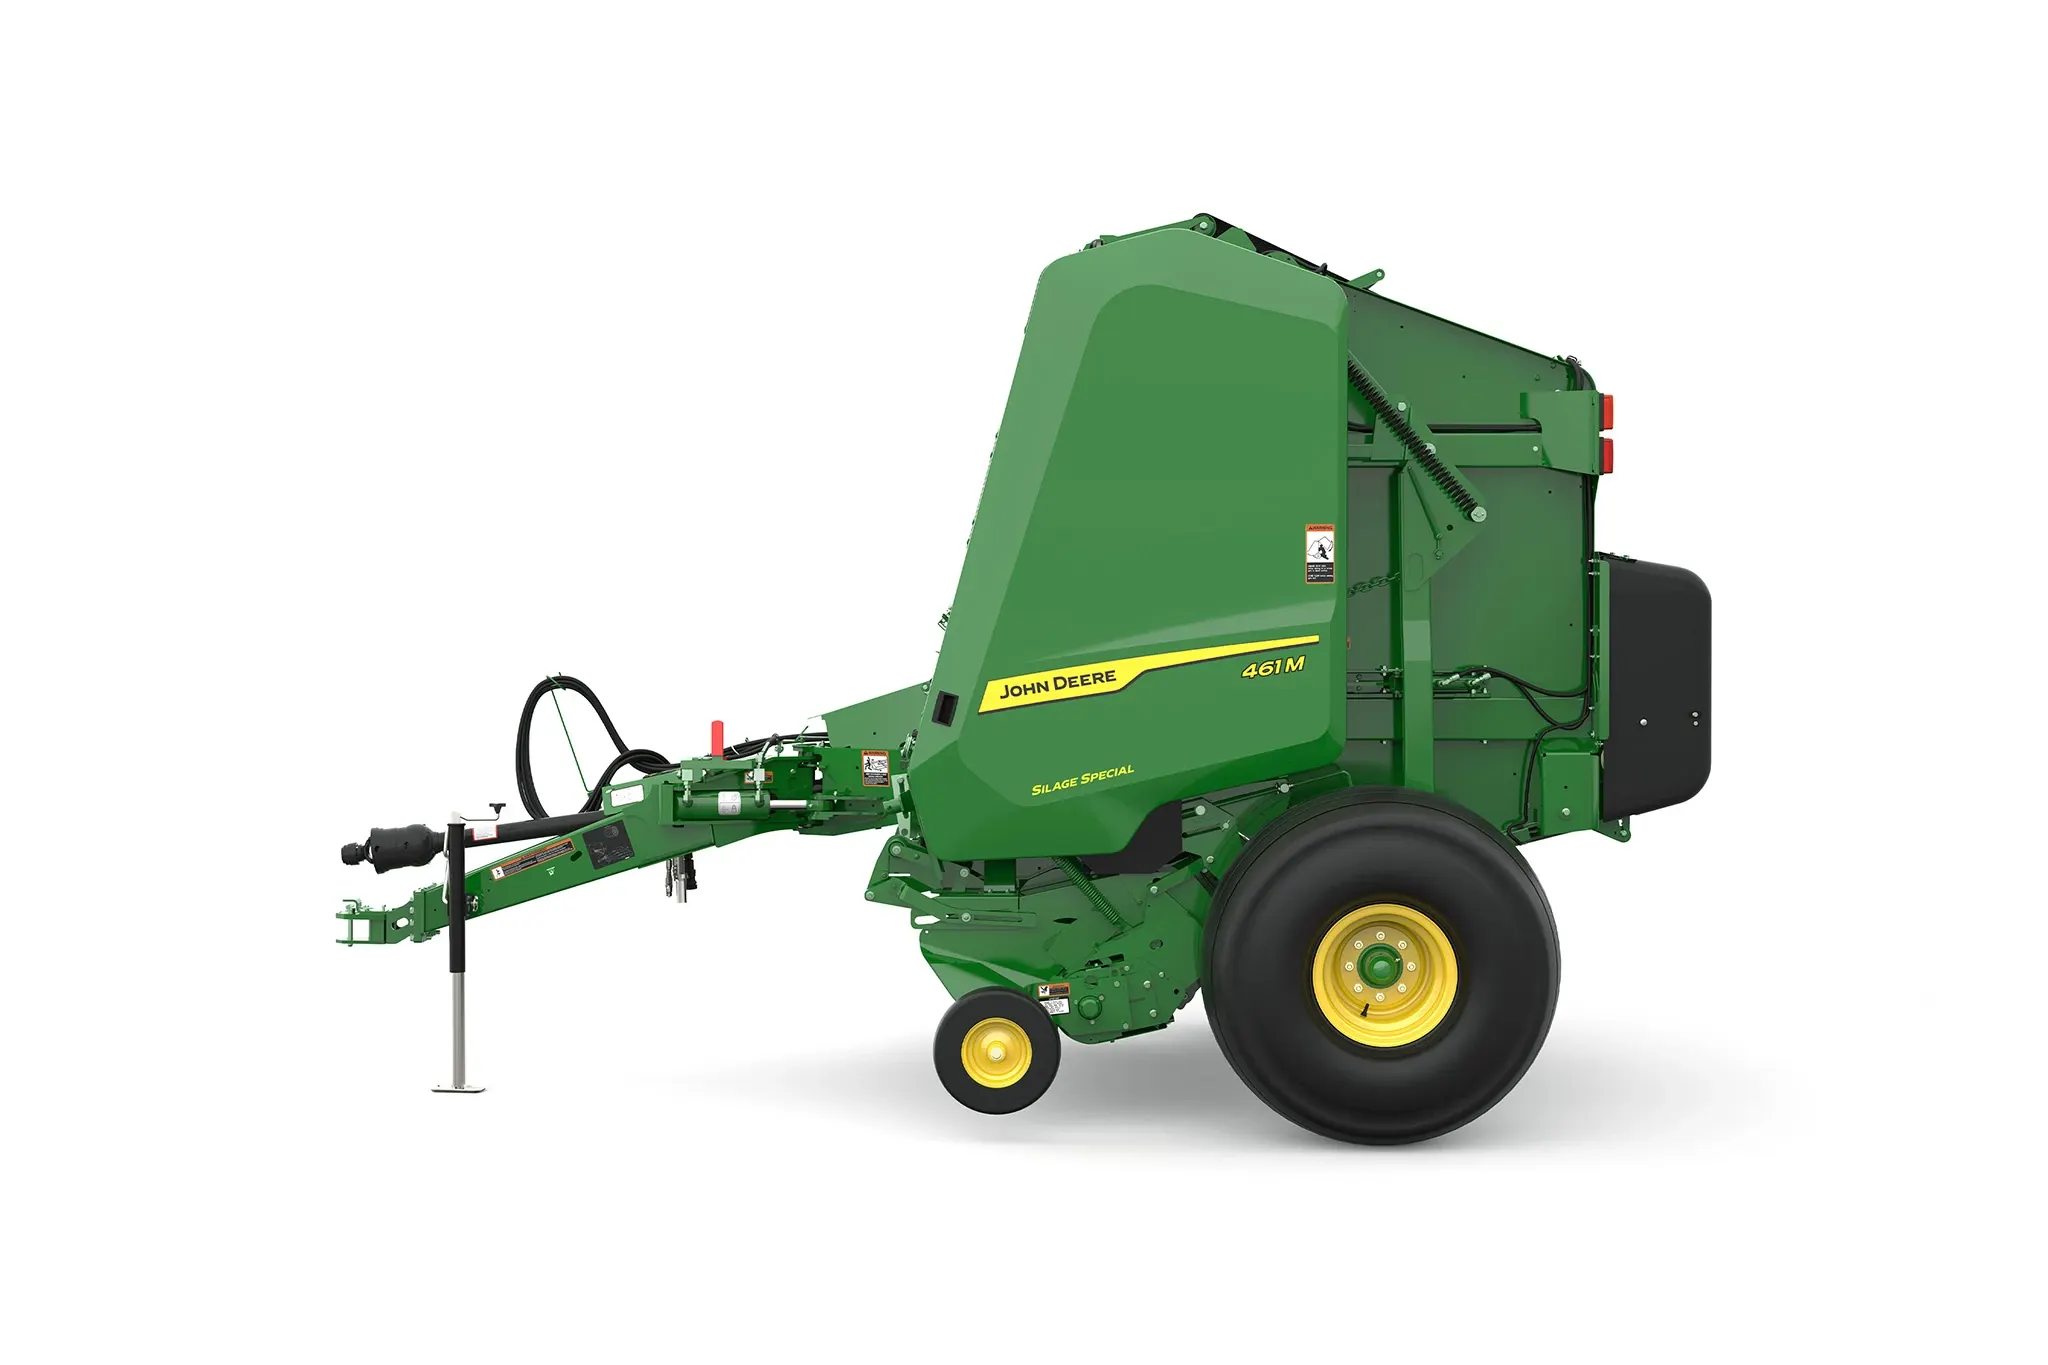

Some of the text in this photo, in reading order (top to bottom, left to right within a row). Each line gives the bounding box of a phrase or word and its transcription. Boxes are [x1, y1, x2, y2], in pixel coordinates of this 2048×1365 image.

[1000, 670, 1117, 699] JOHN DEERE
[1031, 764, 1135, 796] SILAGE SPECIAL
